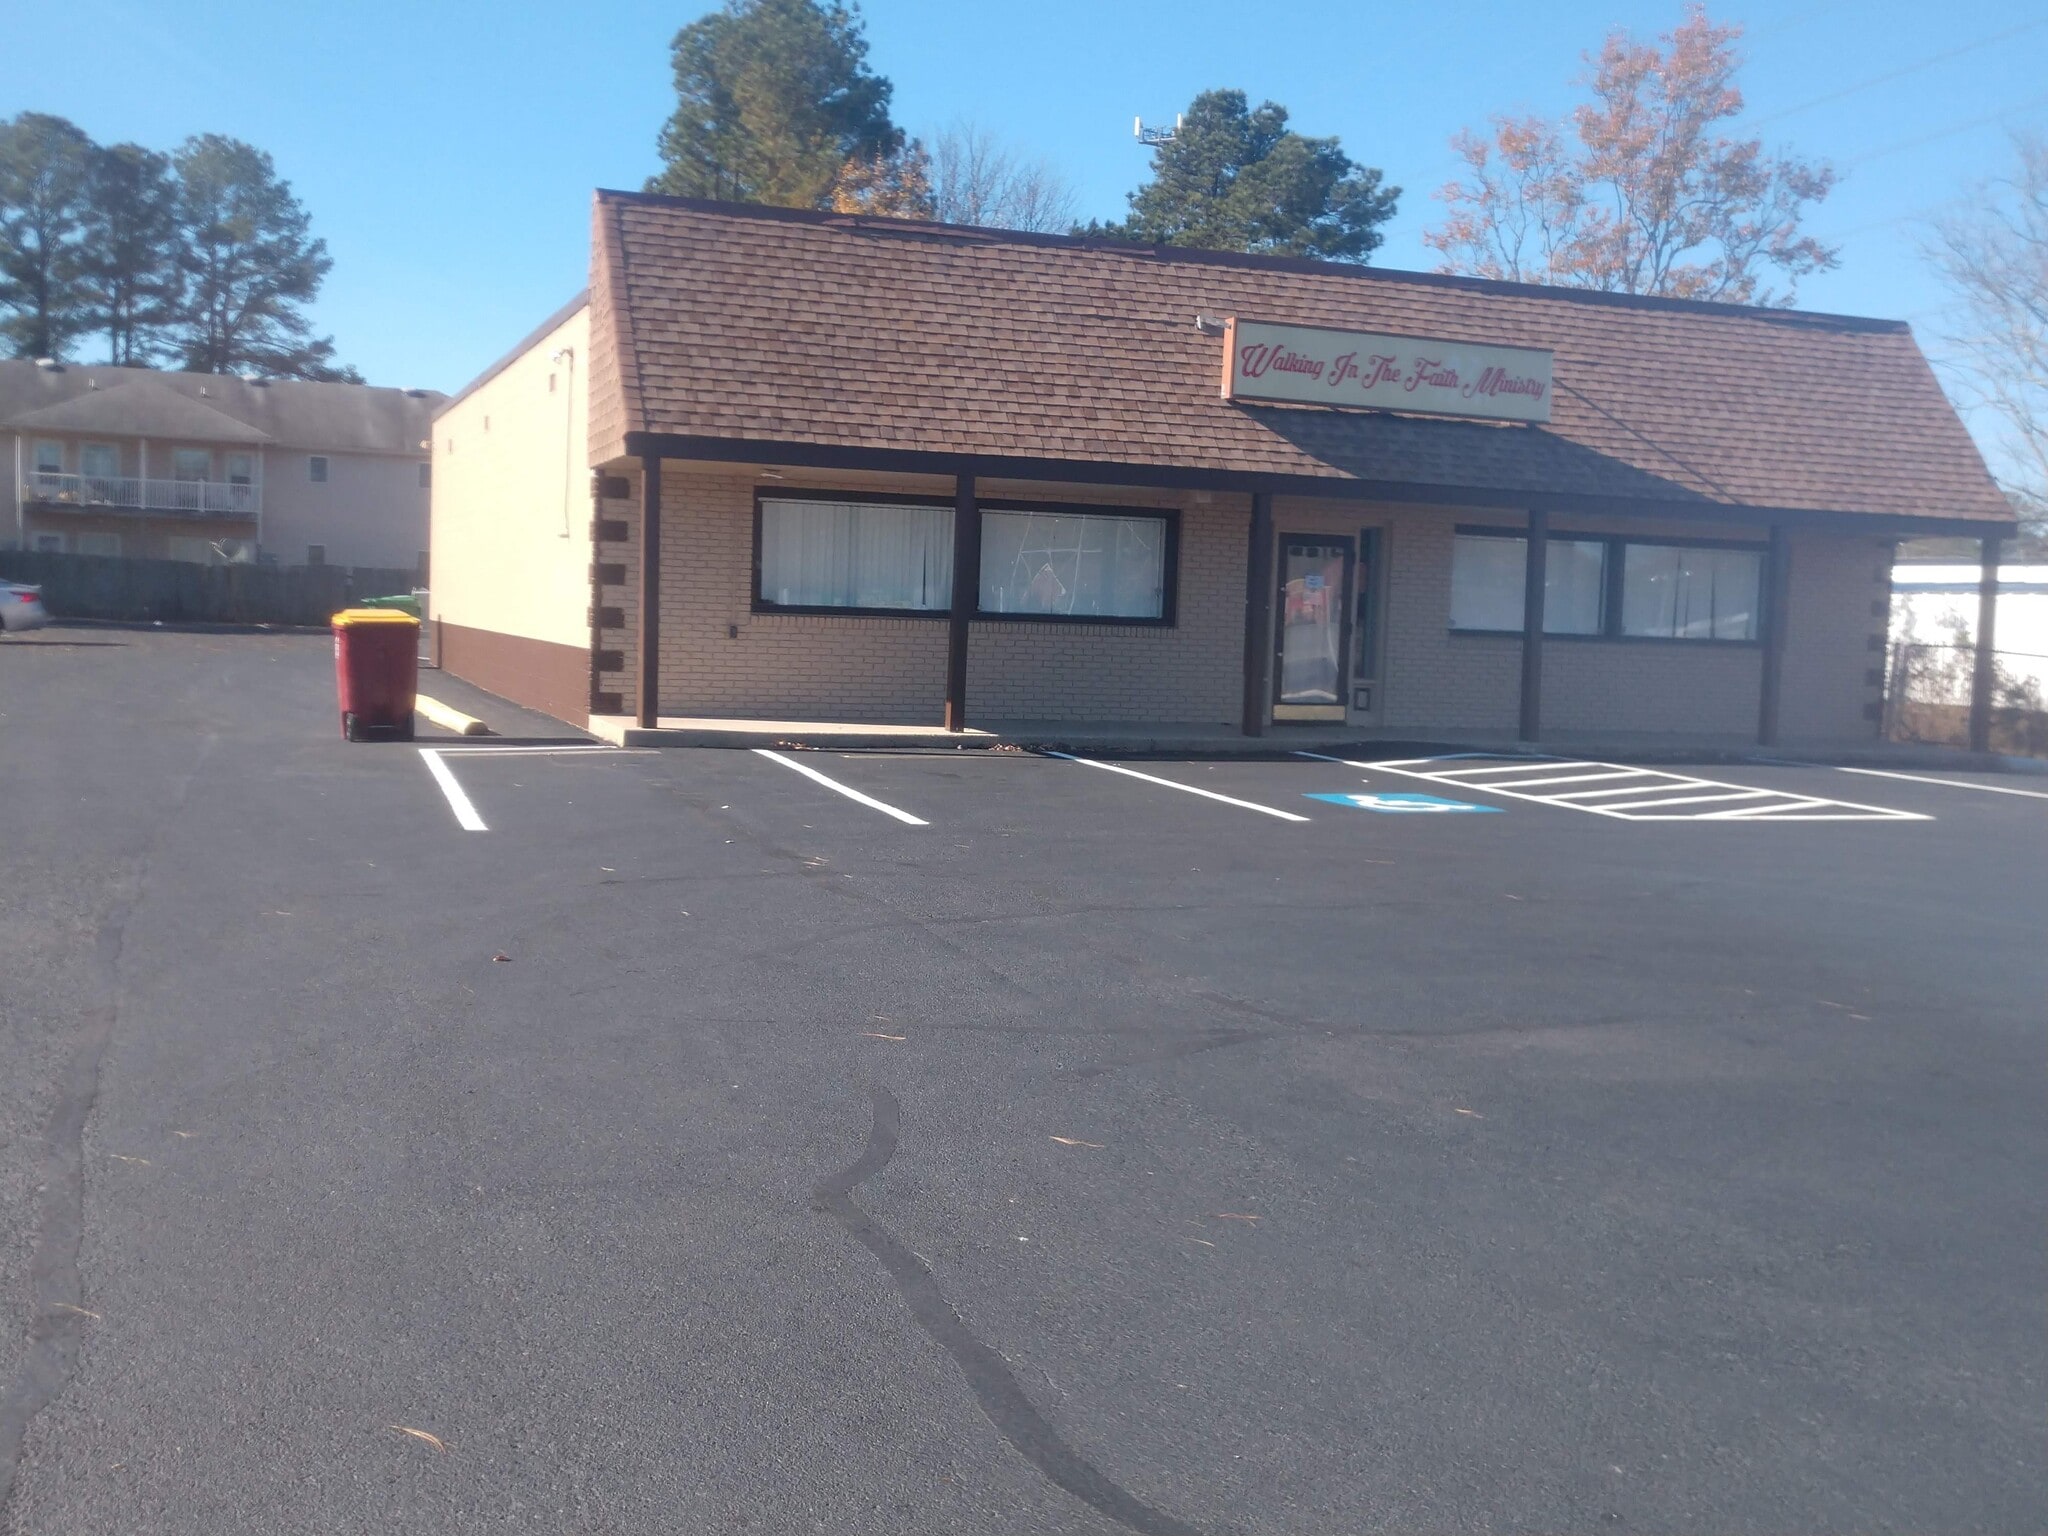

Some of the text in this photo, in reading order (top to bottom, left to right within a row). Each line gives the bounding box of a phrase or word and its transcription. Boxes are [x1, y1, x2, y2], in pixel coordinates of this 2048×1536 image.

[1240, 343, 1546, 400] Walking In The Faith Ministry
